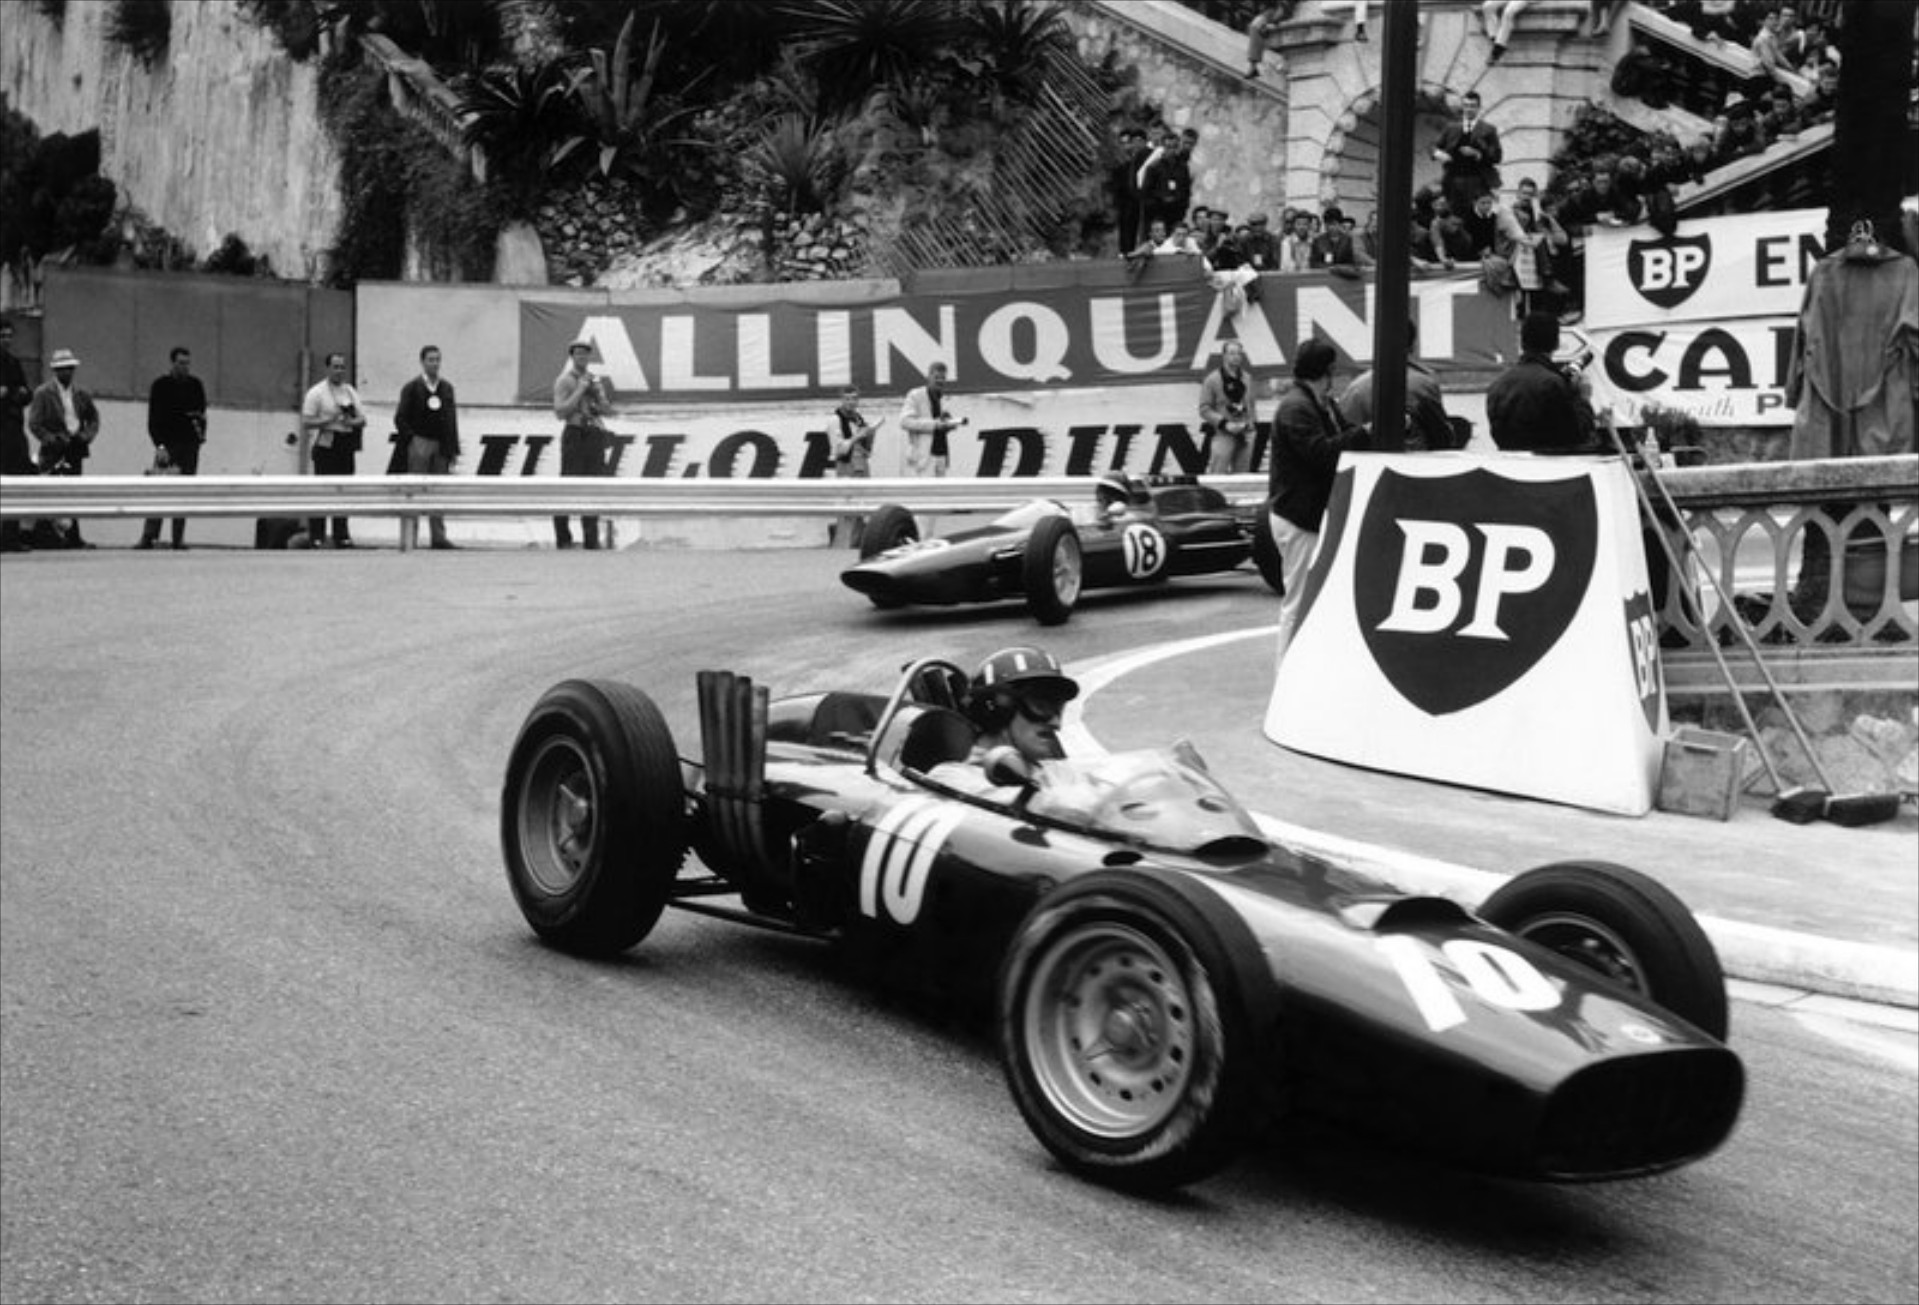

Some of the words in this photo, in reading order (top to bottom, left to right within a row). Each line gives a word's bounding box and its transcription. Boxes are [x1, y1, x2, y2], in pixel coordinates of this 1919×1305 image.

[1639, 246, 1705, 291] BP
[562, 279, 1479, 392] ALLINQUANT
[976, 422, 1274, 478] DUN
[1131, 530, 1157, 577] 18
[1375, 518, 1556, 641] BP
[1630, 615, 1657, 699] BP
[860, 798, 967, 925] 10
[1374, 934, 1563, 1033] 10
